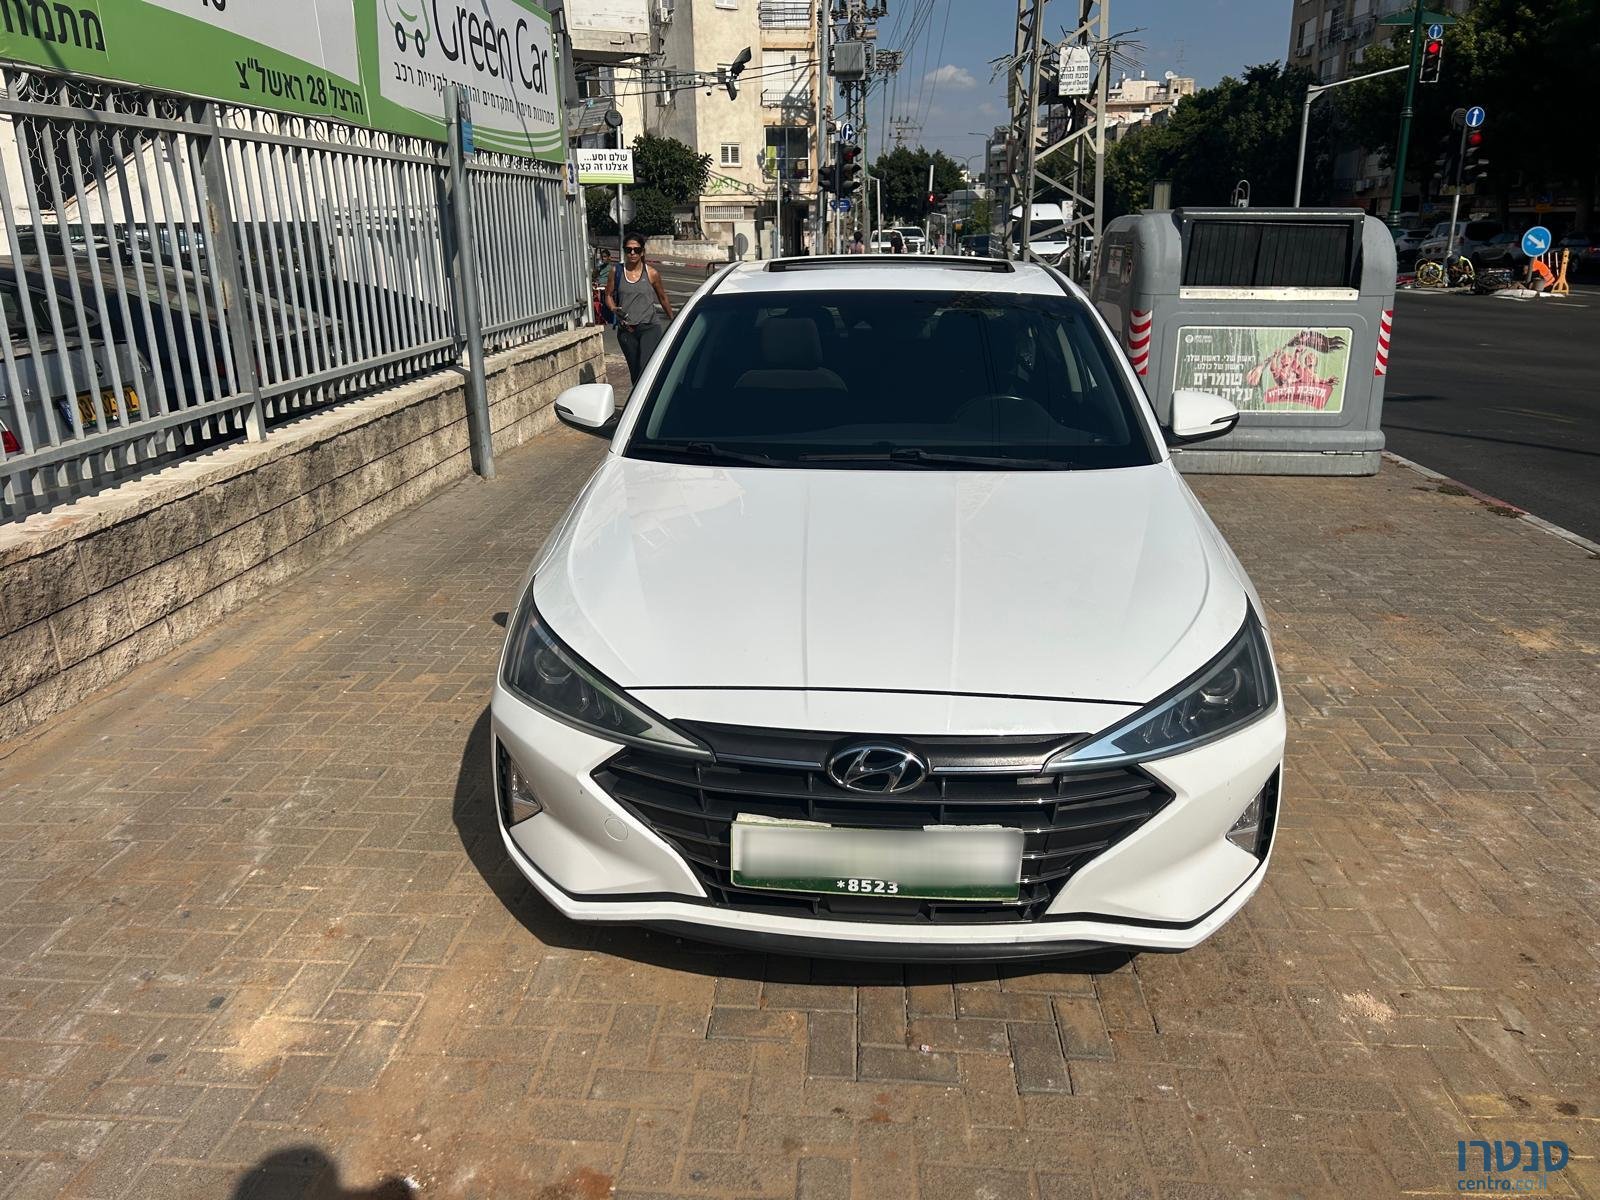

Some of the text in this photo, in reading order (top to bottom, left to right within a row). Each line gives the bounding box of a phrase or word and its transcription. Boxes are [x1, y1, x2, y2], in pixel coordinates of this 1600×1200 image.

[432, 0, 548, 95] Green Car
[394, 61, 414, 84] רכב
[306, 74, 327, 107] 28
[327, 78, 363, 115] הרצל
[482, 90, 515, 115] מתקדמים
[609, 153, 628, 161] שלם
[577, 163, 591, 172] קצ
[605, 163, 628, 171] אצלנו
[1193, 372, 1243, 386] שומרים
[1221, 385, 1254, 401] עליה
